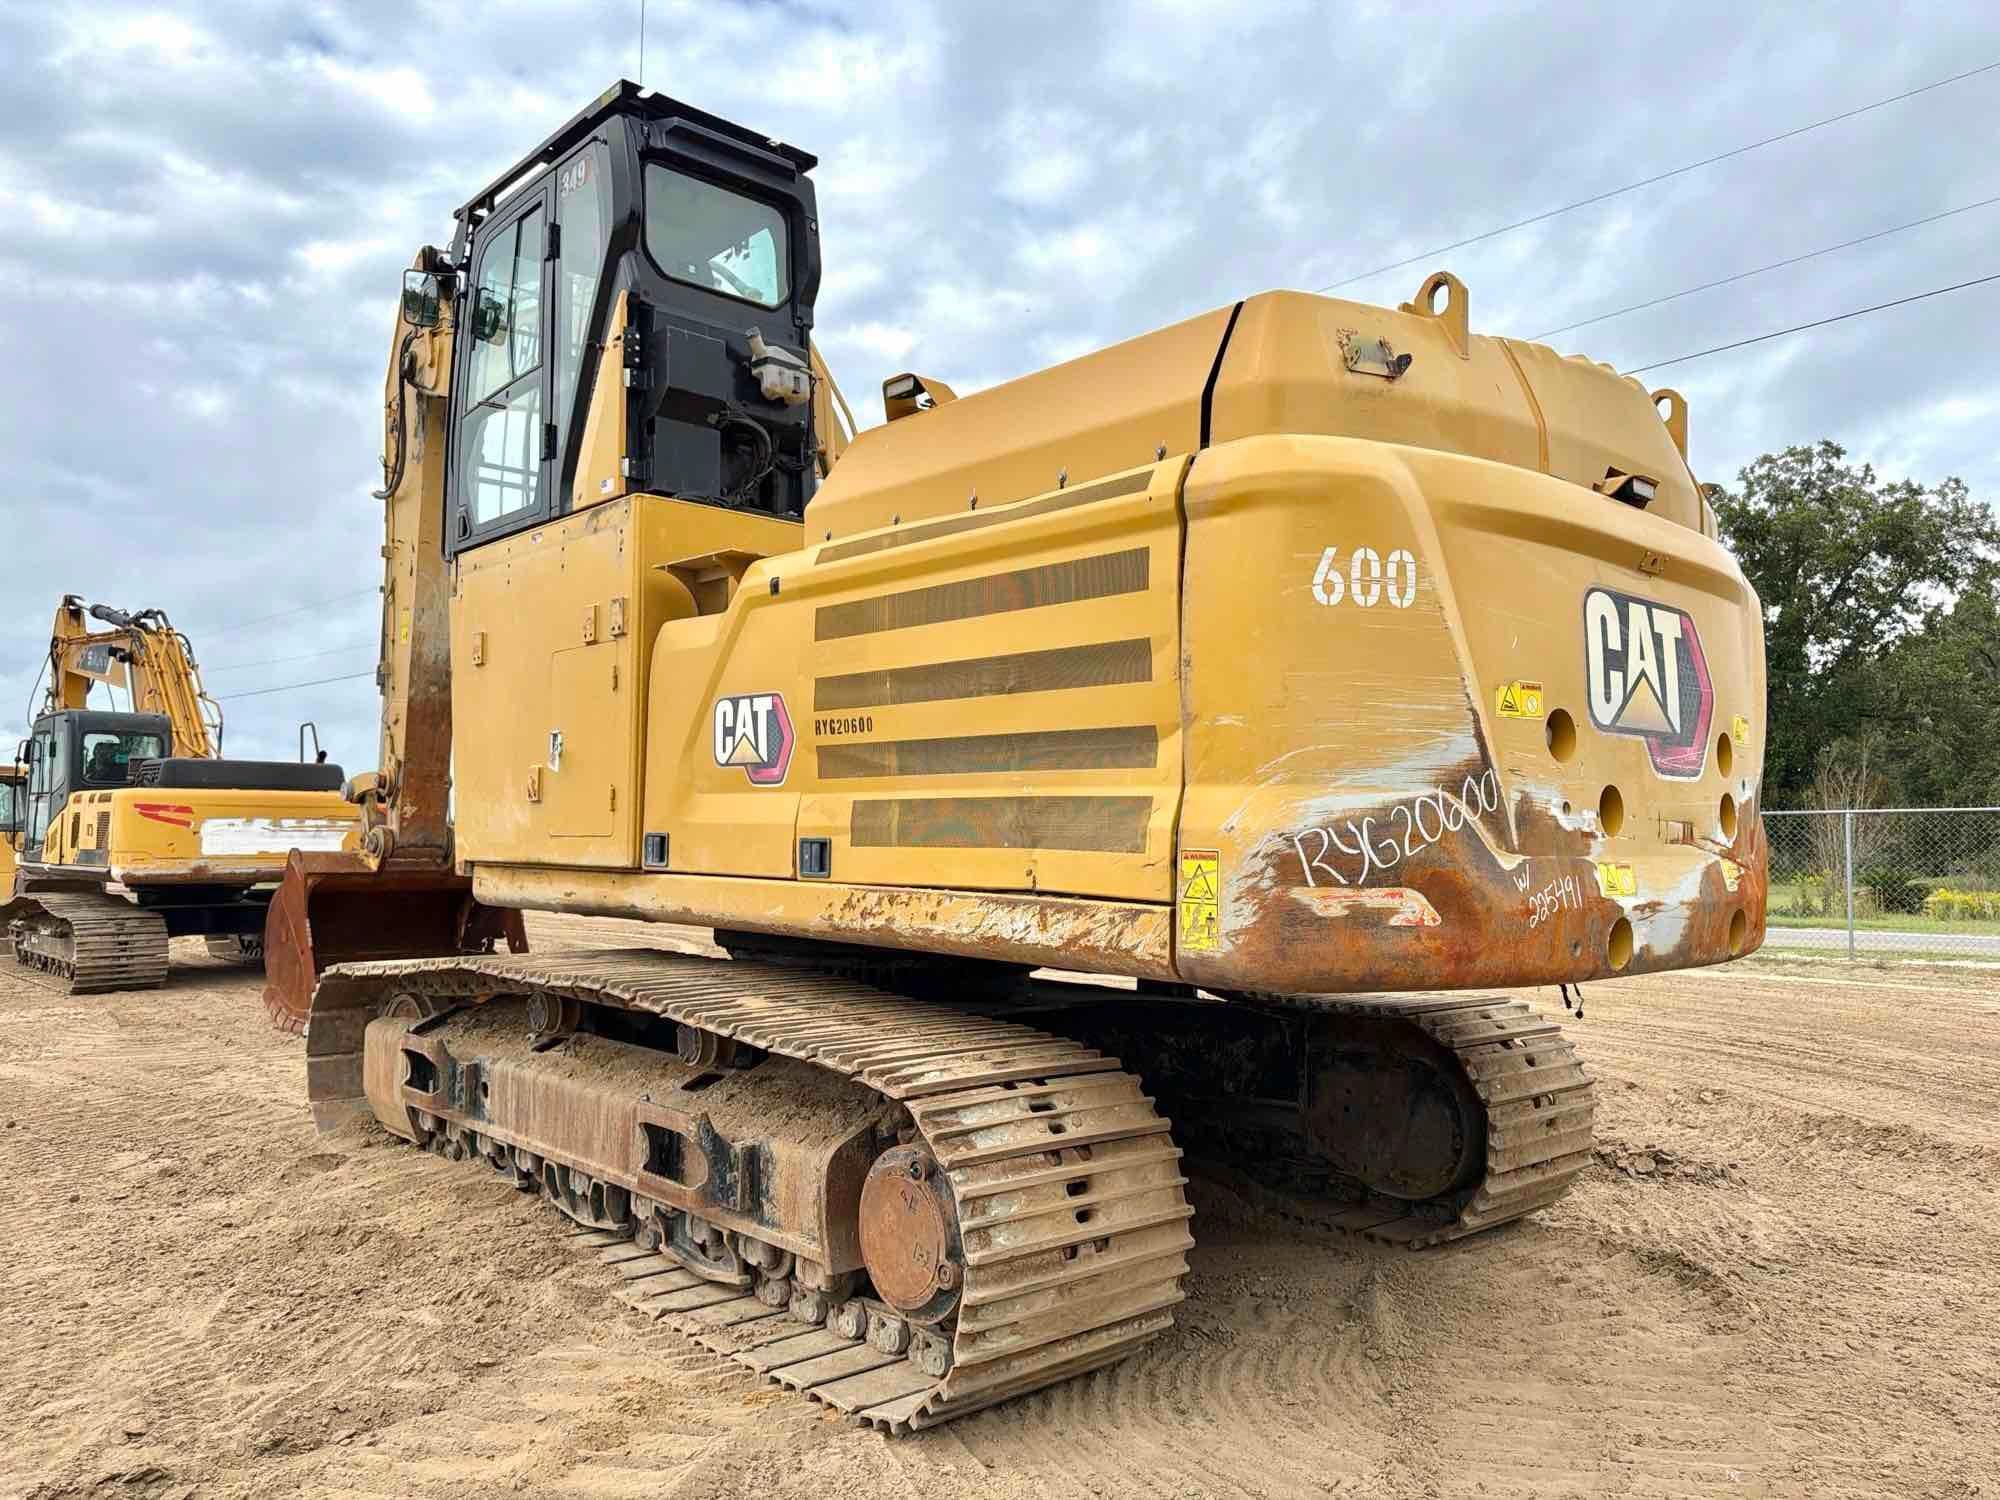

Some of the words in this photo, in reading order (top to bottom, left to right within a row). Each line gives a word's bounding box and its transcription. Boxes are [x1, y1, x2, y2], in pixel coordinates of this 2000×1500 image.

[1312, 547, 1416, 609] 600
[1586, 591, 1682, 734] CAT
[715, 696, 773, 764] CAT
[815, 716, 873, 736] RYG20600
[1294, 768, 1498, 887] RYG20600
[1528, 875, 1582, 928] 225491
